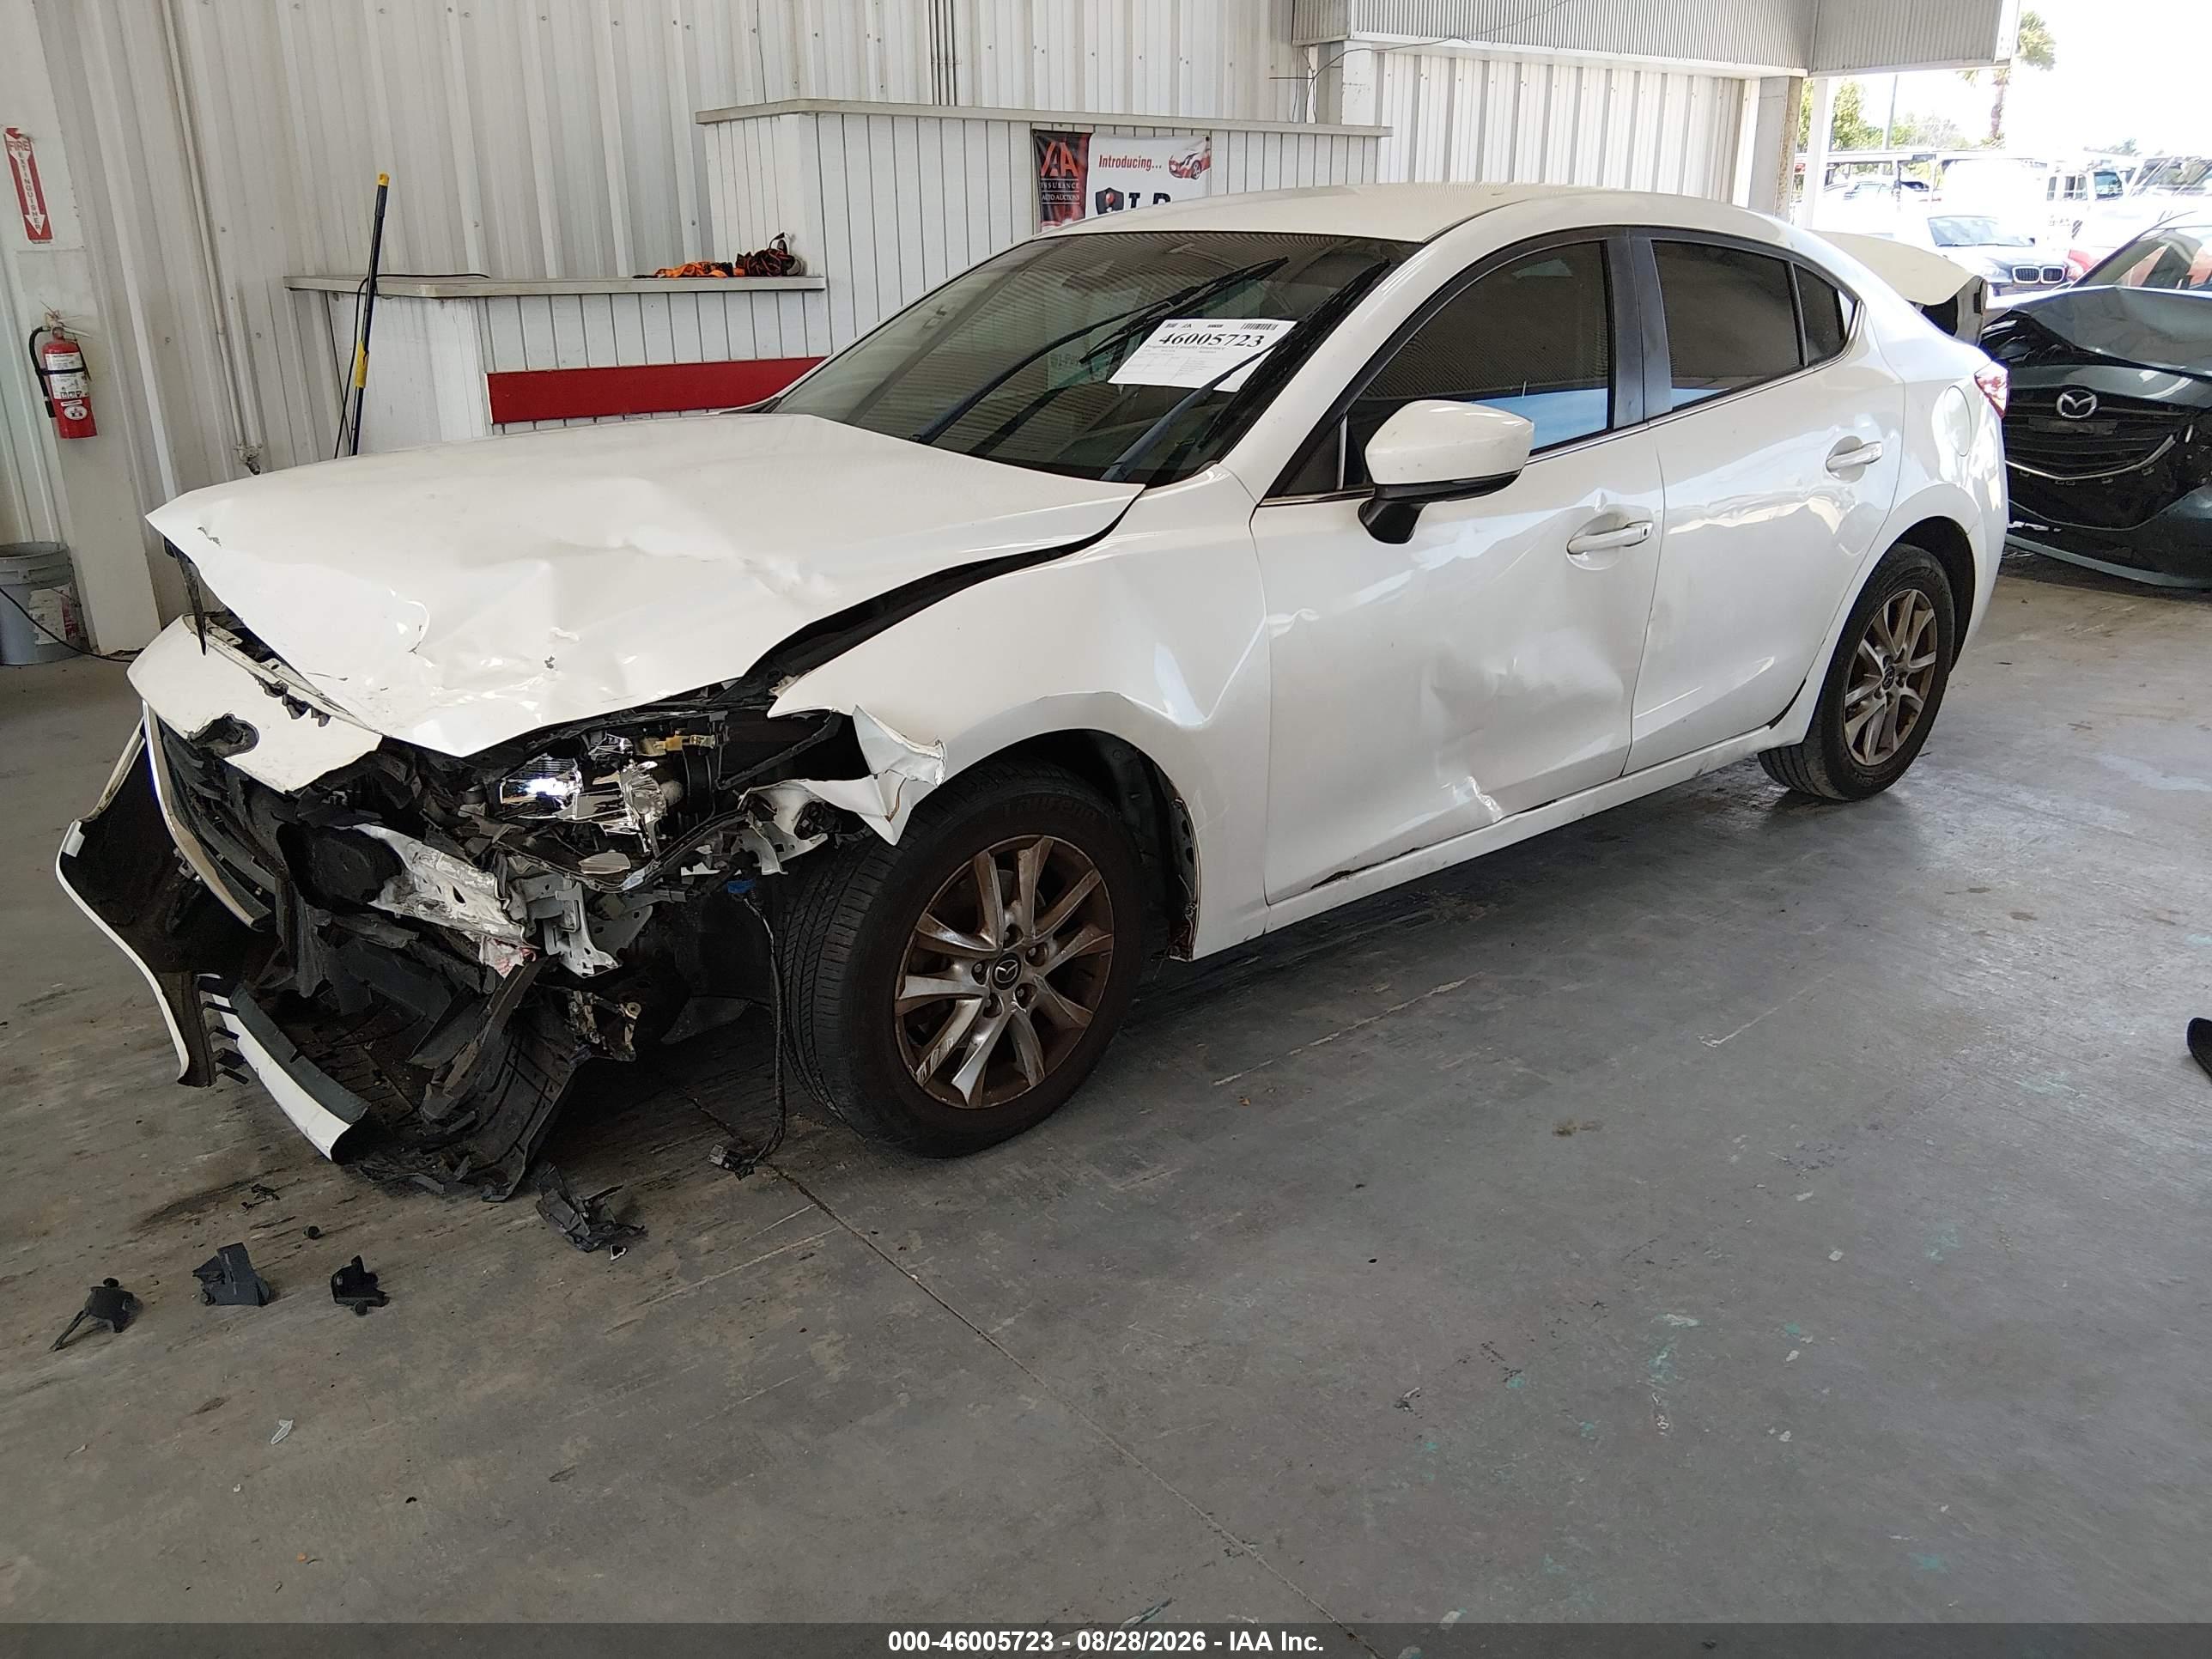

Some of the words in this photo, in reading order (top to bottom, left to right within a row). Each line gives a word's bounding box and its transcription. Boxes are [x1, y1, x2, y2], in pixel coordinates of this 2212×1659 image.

[7, 140, 31, 151] FIRE
[1099, 155, 1162, 171] Introducing...
[1159, 332, 1264, 347] 46005723
